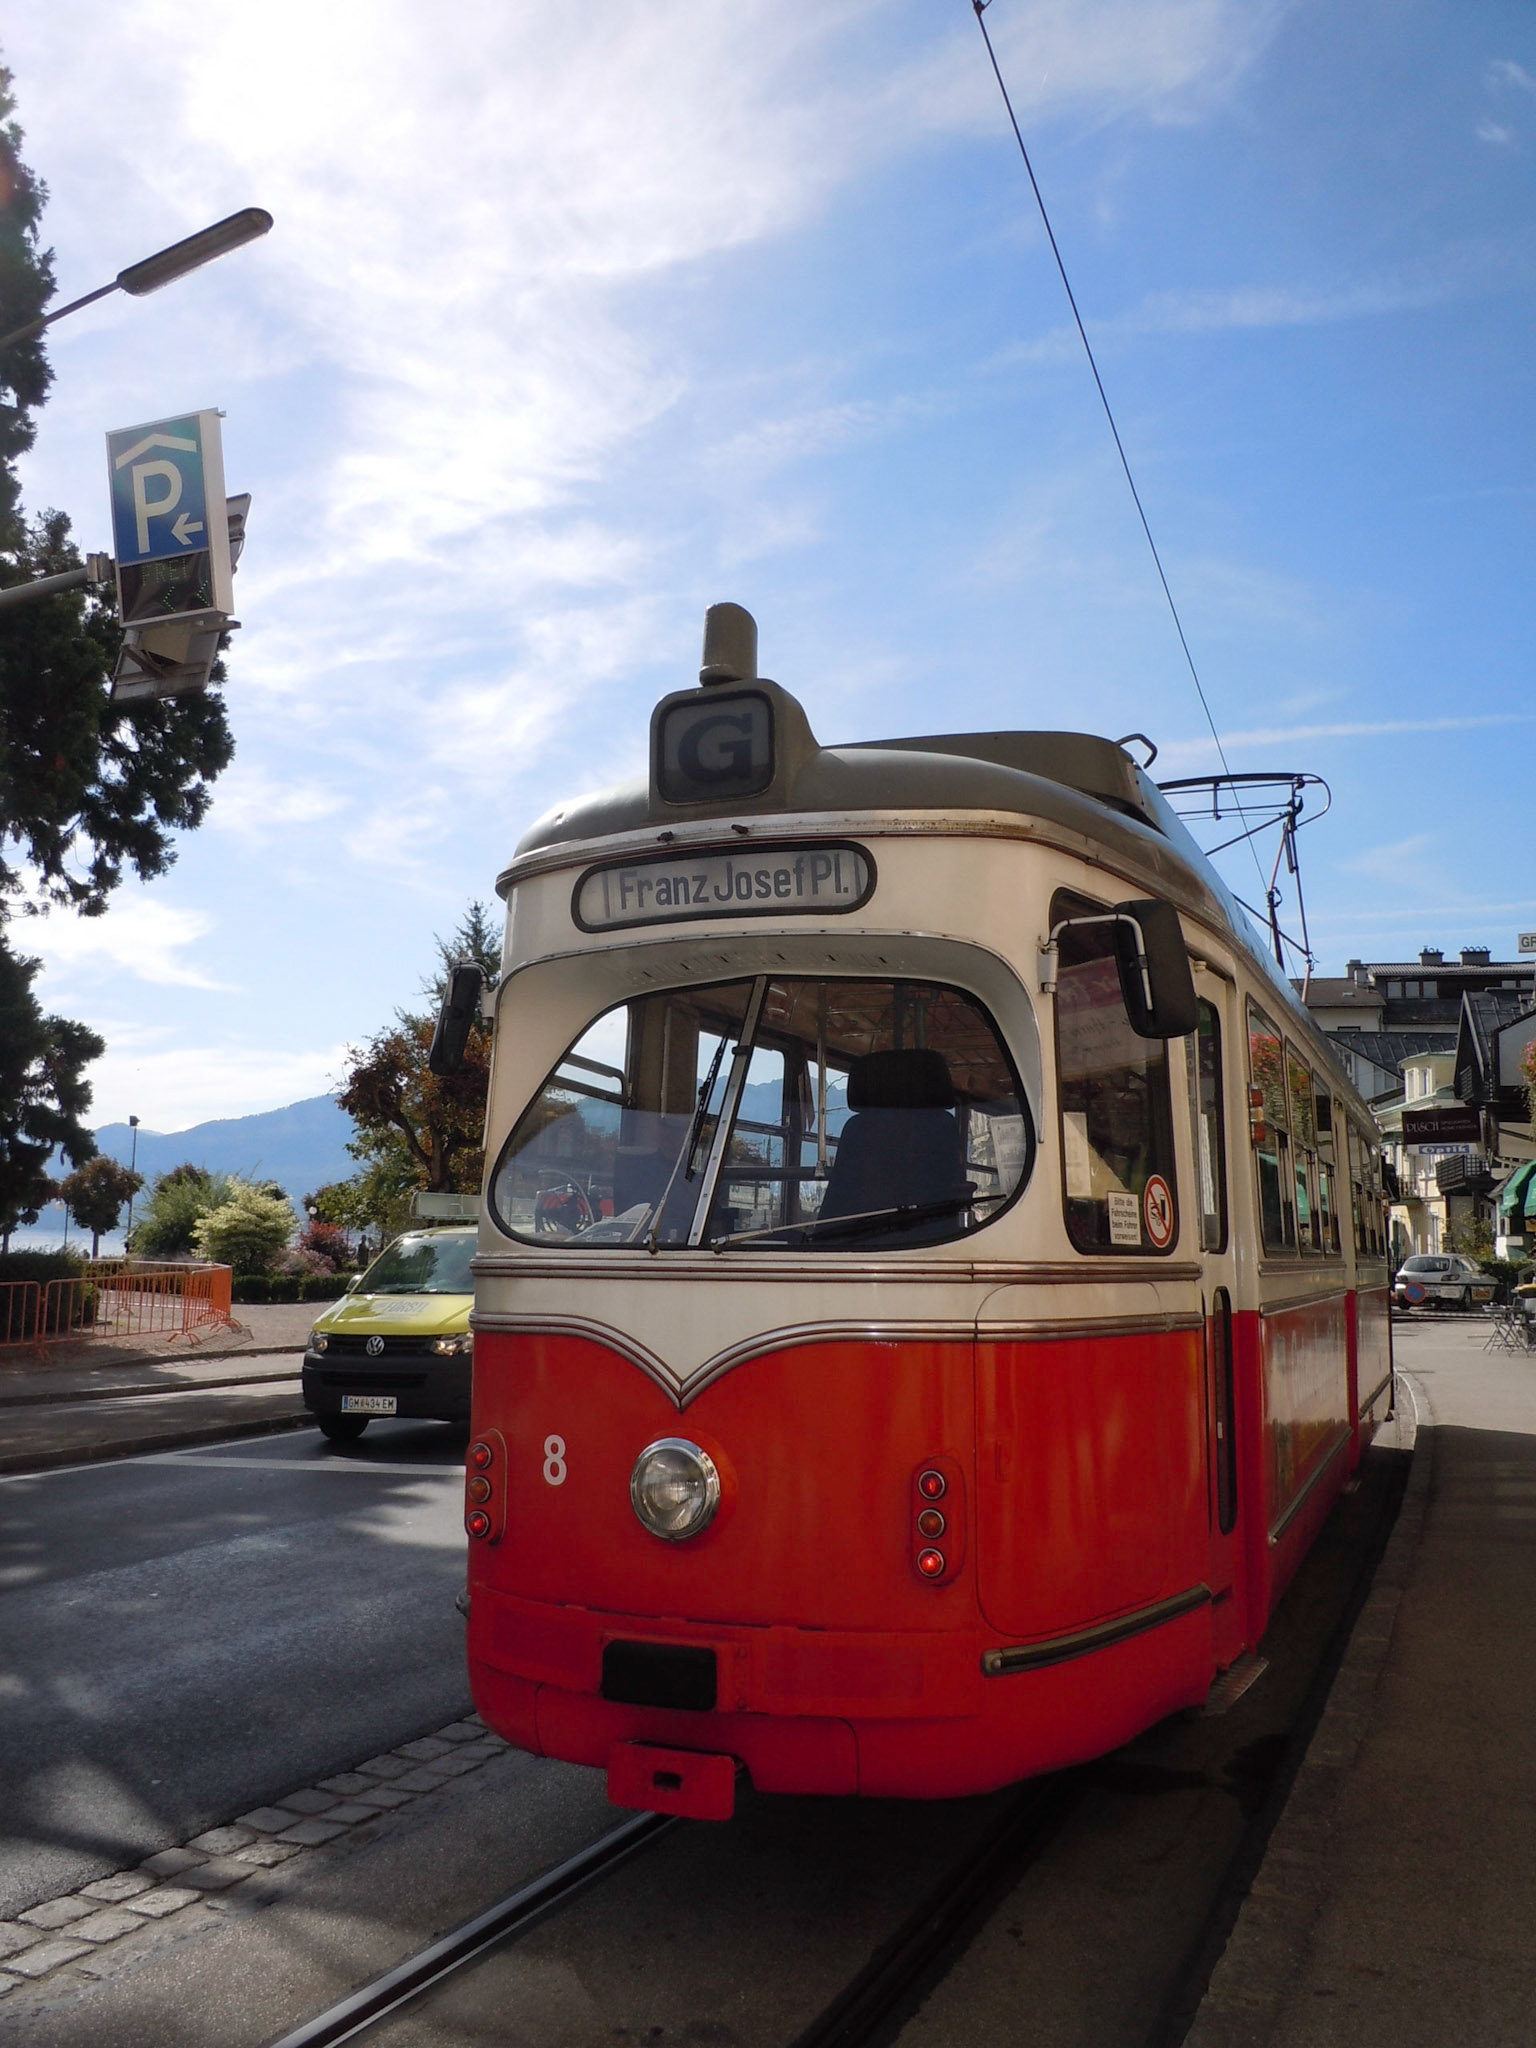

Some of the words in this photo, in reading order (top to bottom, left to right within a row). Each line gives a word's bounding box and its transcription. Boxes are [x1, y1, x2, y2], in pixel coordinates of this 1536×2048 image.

[132, 460, 183, 554] P
[678, 712, 753, 784] G
[619, 870, 709, 910] Franz
[714, 857, 806, 901] Josef
[1421, 1145, 1467, 1154] Optik
[542, 1434, 568, 1486] 8
